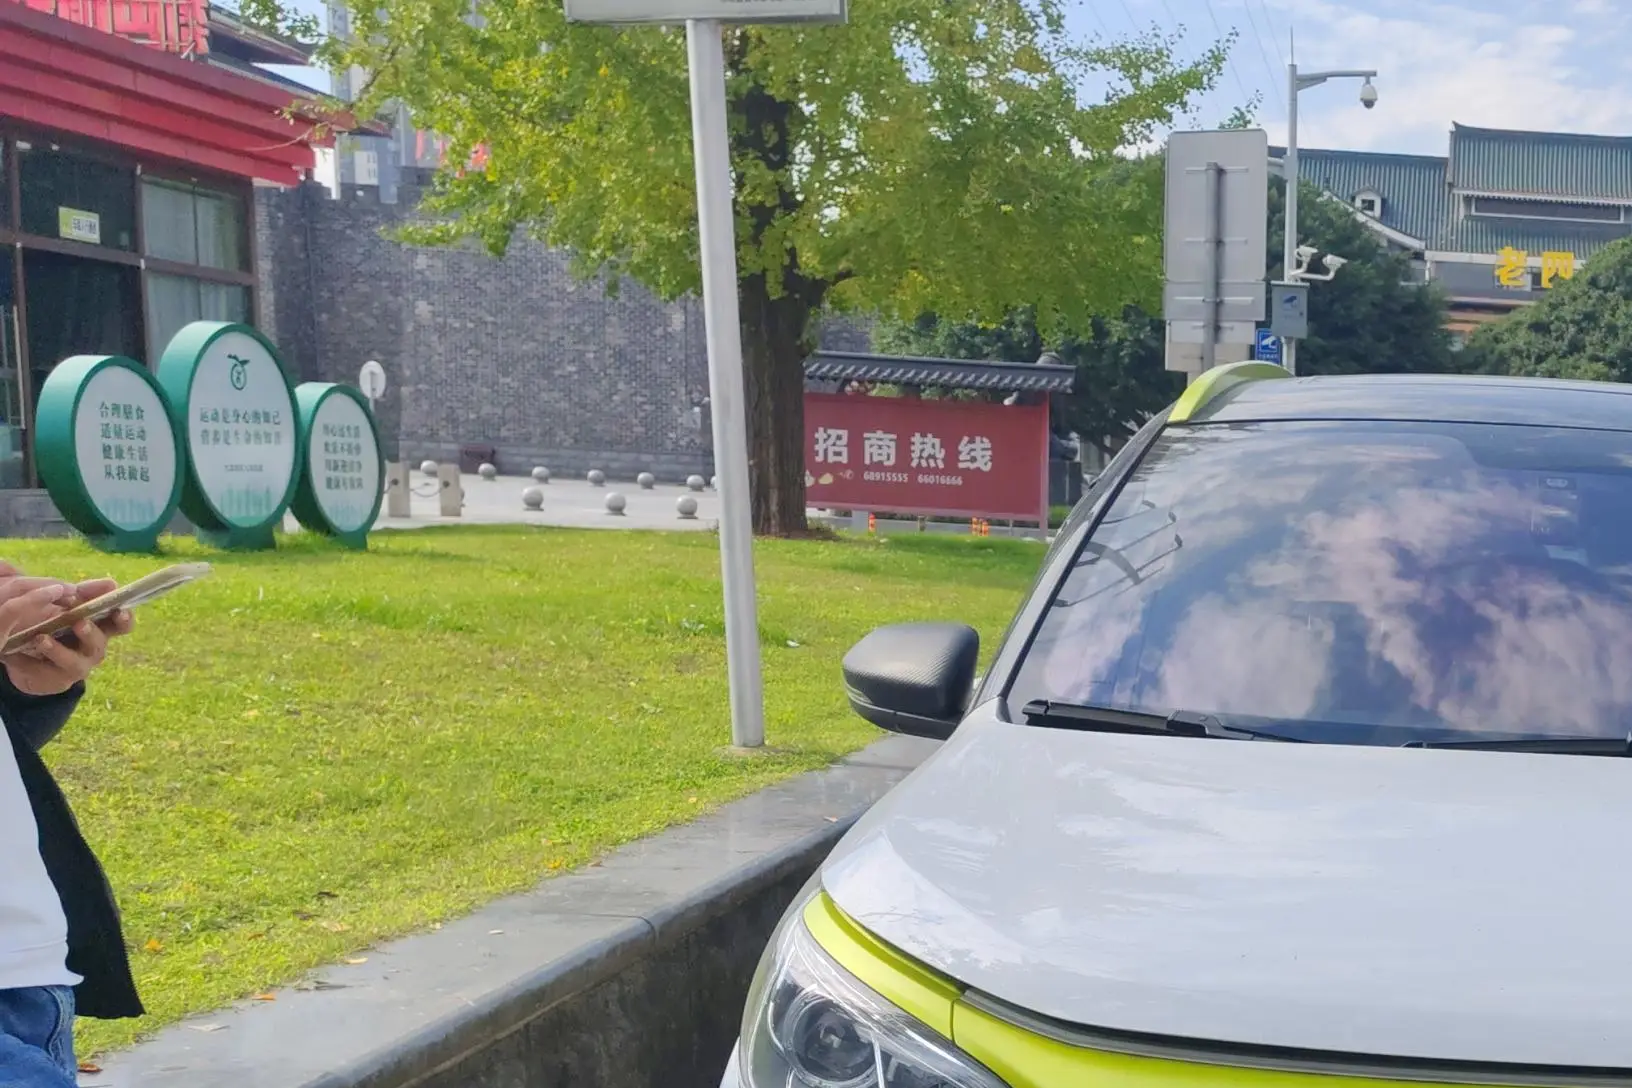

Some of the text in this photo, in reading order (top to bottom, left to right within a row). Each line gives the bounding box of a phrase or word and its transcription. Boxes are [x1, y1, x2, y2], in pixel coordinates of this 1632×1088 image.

[99, 401, 145, 420] 合理膳食
[101, 423, 147, 441] 适量运动
[102, 443, 148, 461] 健康生活
[814, 427, 993, 472] 招商热线
[104, 464, 150, 482] 从我做起
